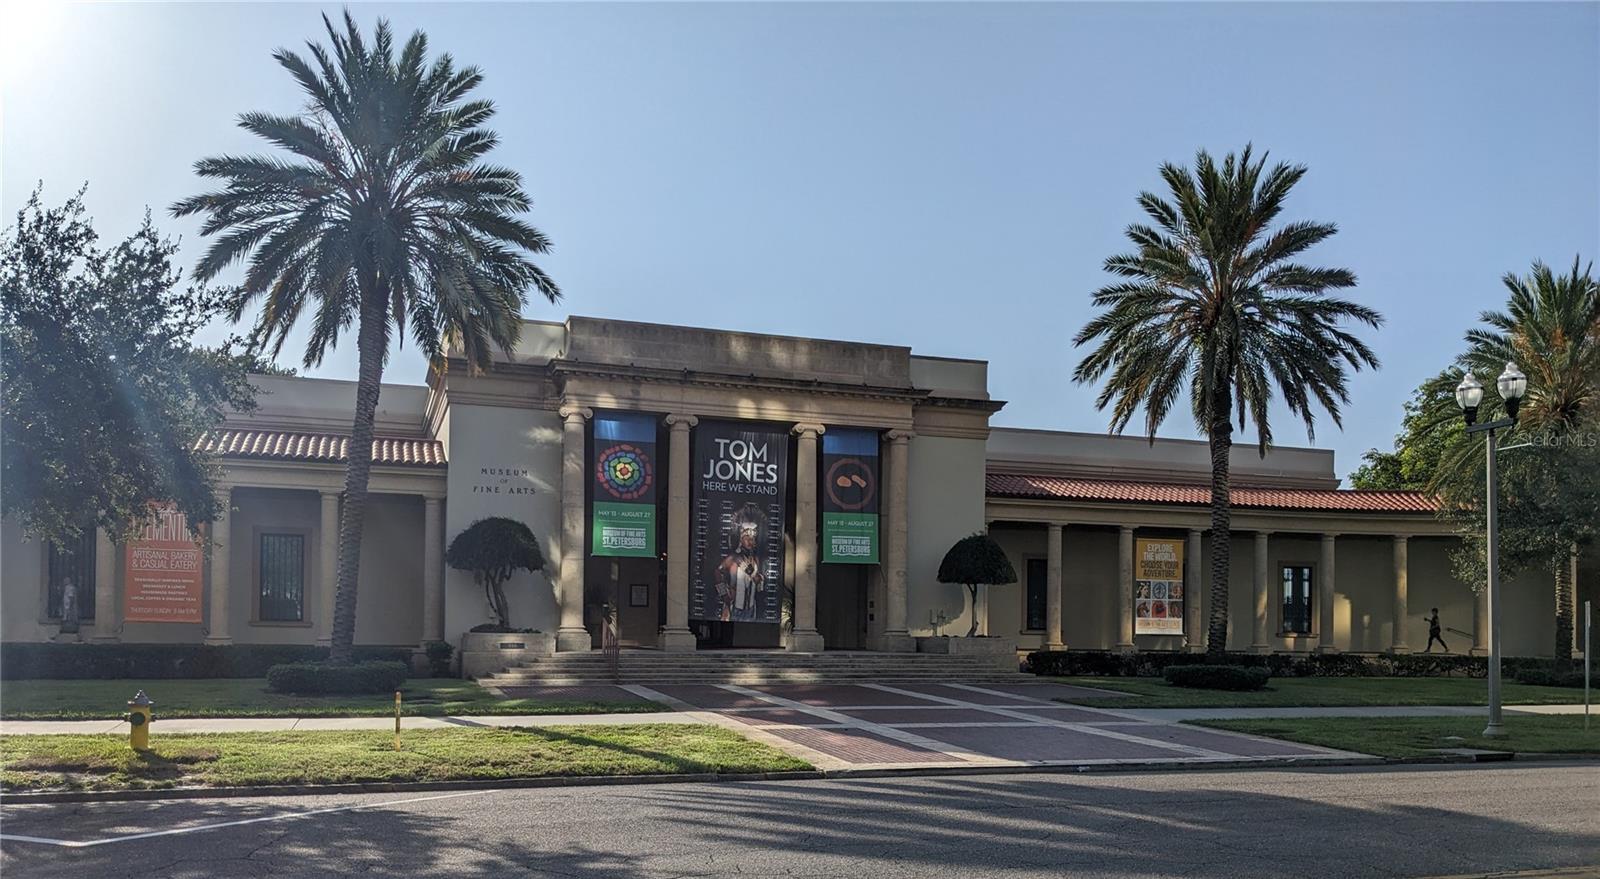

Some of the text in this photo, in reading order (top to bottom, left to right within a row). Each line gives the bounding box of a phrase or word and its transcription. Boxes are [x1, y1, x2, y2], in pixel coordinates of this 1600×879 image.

[714, 438, 768, 462] TOM
[481, 468, 528, 477] MUSEUM
[703, 459, 778, 484] JONES
[473, 486, 537, 495] FINE ARTS
[702, 481, 778, 496] HERE WE STAND
[1147, 543, 1174, 552] EXPLORE
[132, 550, 198, 561] ARTISANAL BAKERY
[1143, 551, 1156, 560] THE
[132, 559, 198, 570] & CASUAL EATERY
[1140, 560, 1179, 569] CHOOSE YOUR
